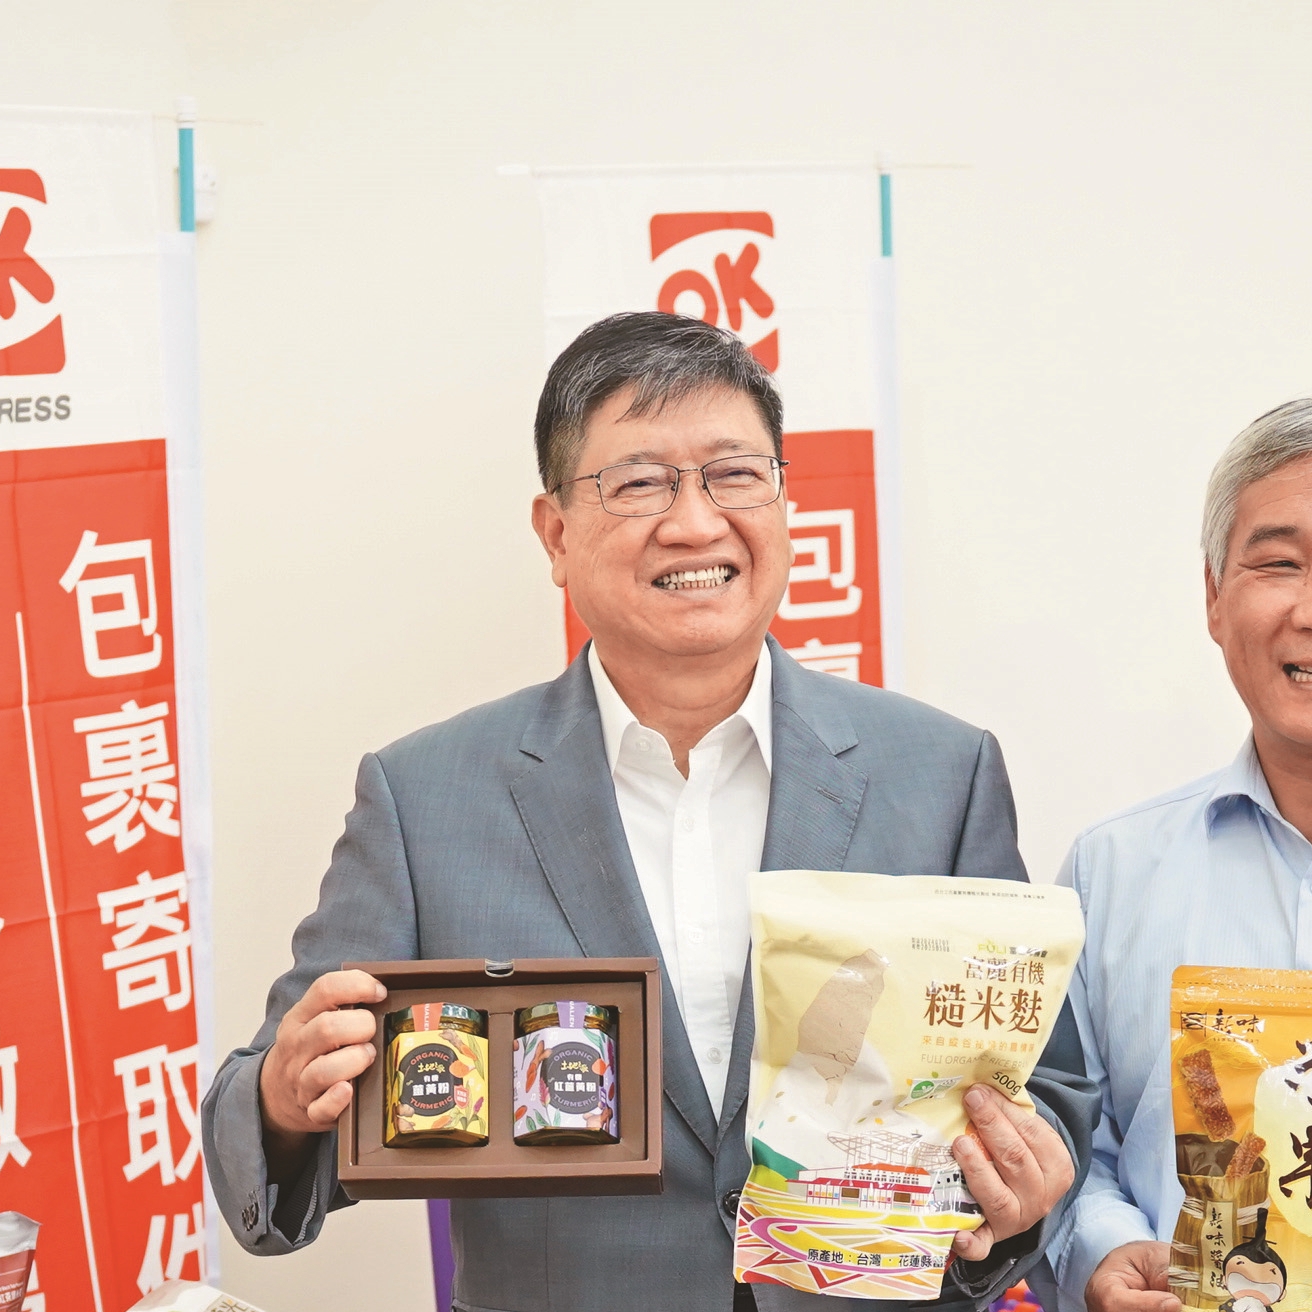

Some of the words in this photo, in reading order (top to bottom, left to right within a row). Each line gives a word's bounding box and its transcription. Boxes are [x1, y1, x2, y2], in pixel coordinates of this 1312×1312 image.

[658, 242, 775, 332] OK
[923, 980, 1043, 1034] 糙米麩
[410, 1050, 450, 1066] ORGANIC
[554, 1050, 593, 1062] ORGANIC
[921, 1053, 942, 1063] FULI
[989, 1056, 1010, 1067] RICE
[423, 1074, 439, 1082] 有機
[567, 1073, 582, 1081] 有機
[992, 1070, 1022, 1095] 500g
[412, 1081, 450, 1096] 薑黃粉
[554, 1080, 597, 1093] 紅薑黃粉
[410, 1096, 454, 1110] TURMERIC
[553, 1093, 597, 1109] TURMERIC
